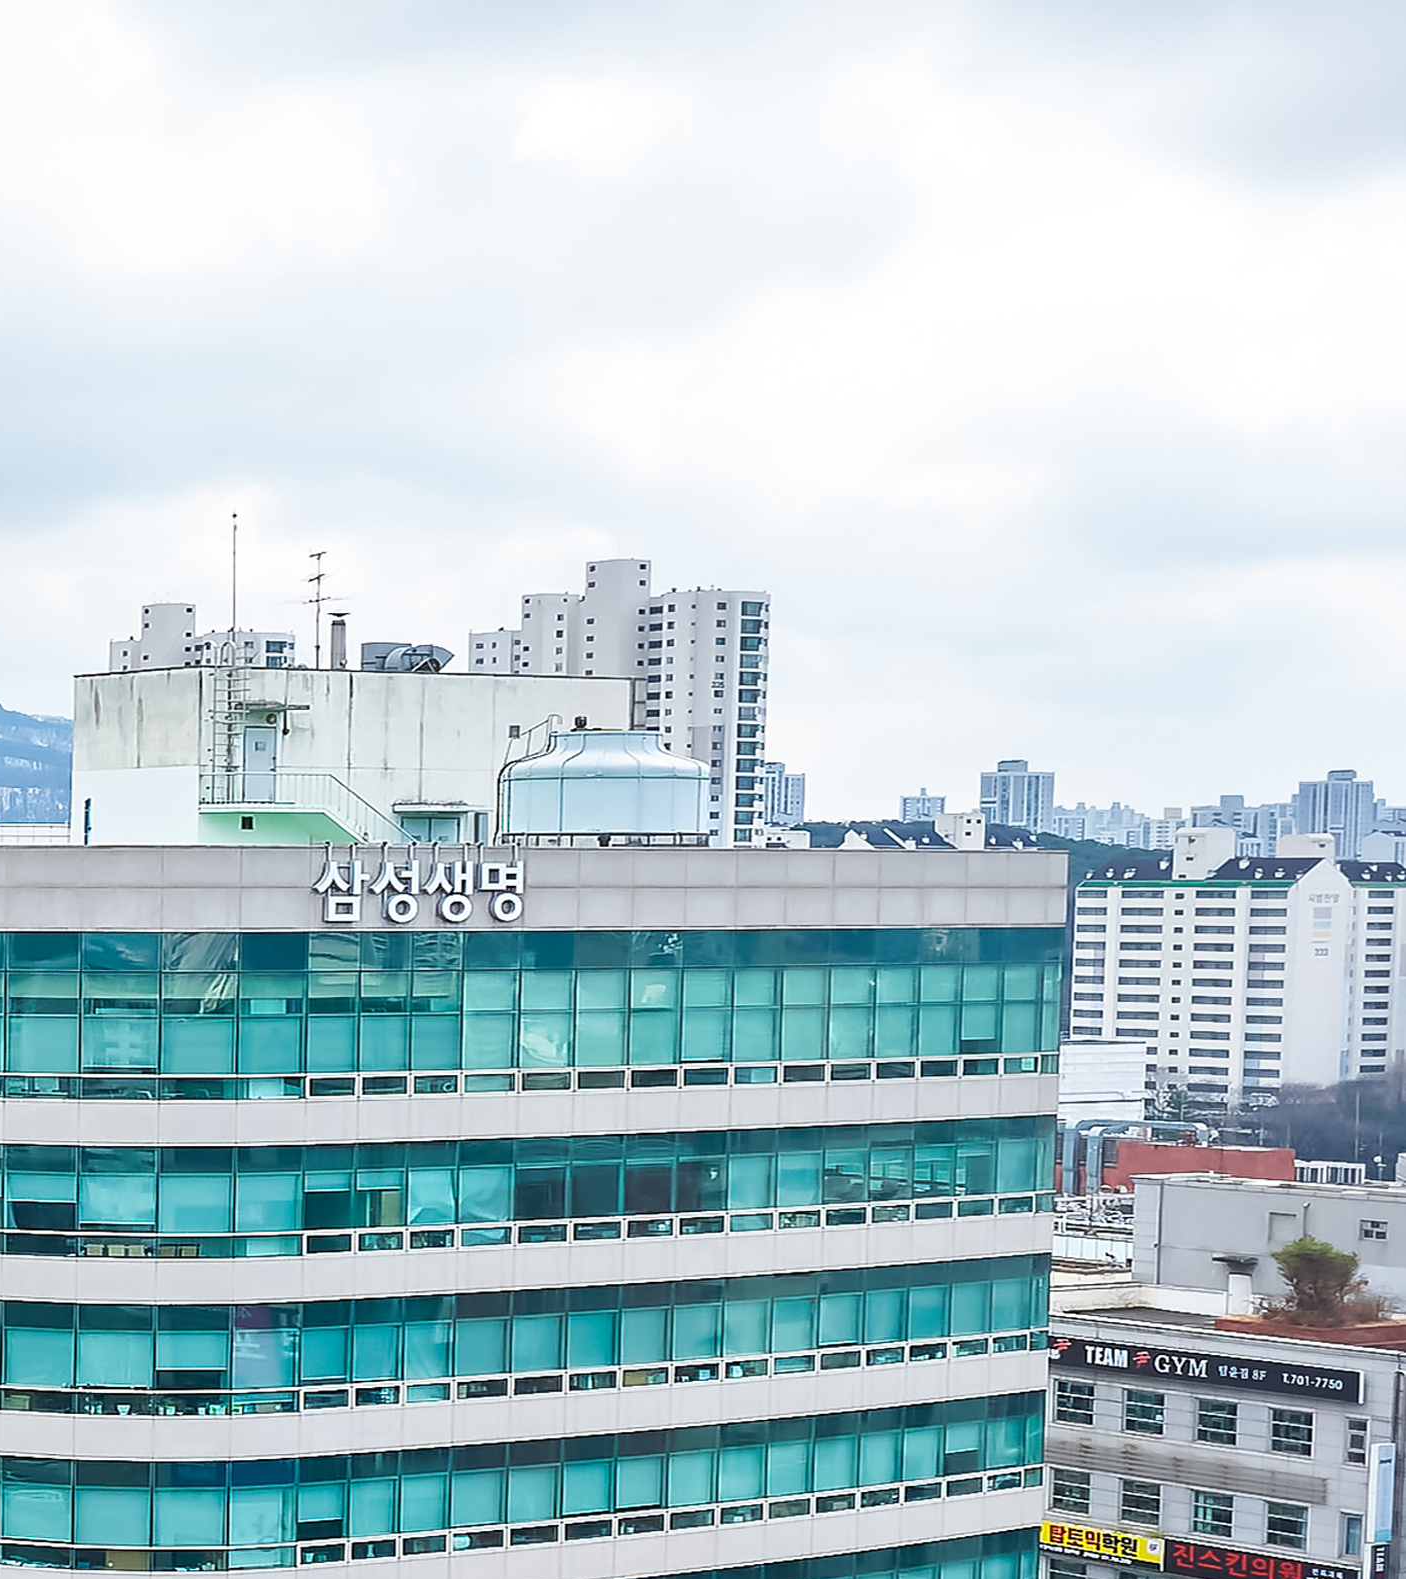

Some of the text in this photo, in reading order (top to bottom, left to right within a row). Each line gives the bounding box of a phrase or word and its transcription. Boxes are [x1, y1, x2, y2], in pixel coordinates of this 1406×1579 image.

[312, 860, 525, 923] 삼성생명
[1085, 1345, 1128, 1368] TEAM
[1154, 1354, 1208, 1378] GYM
